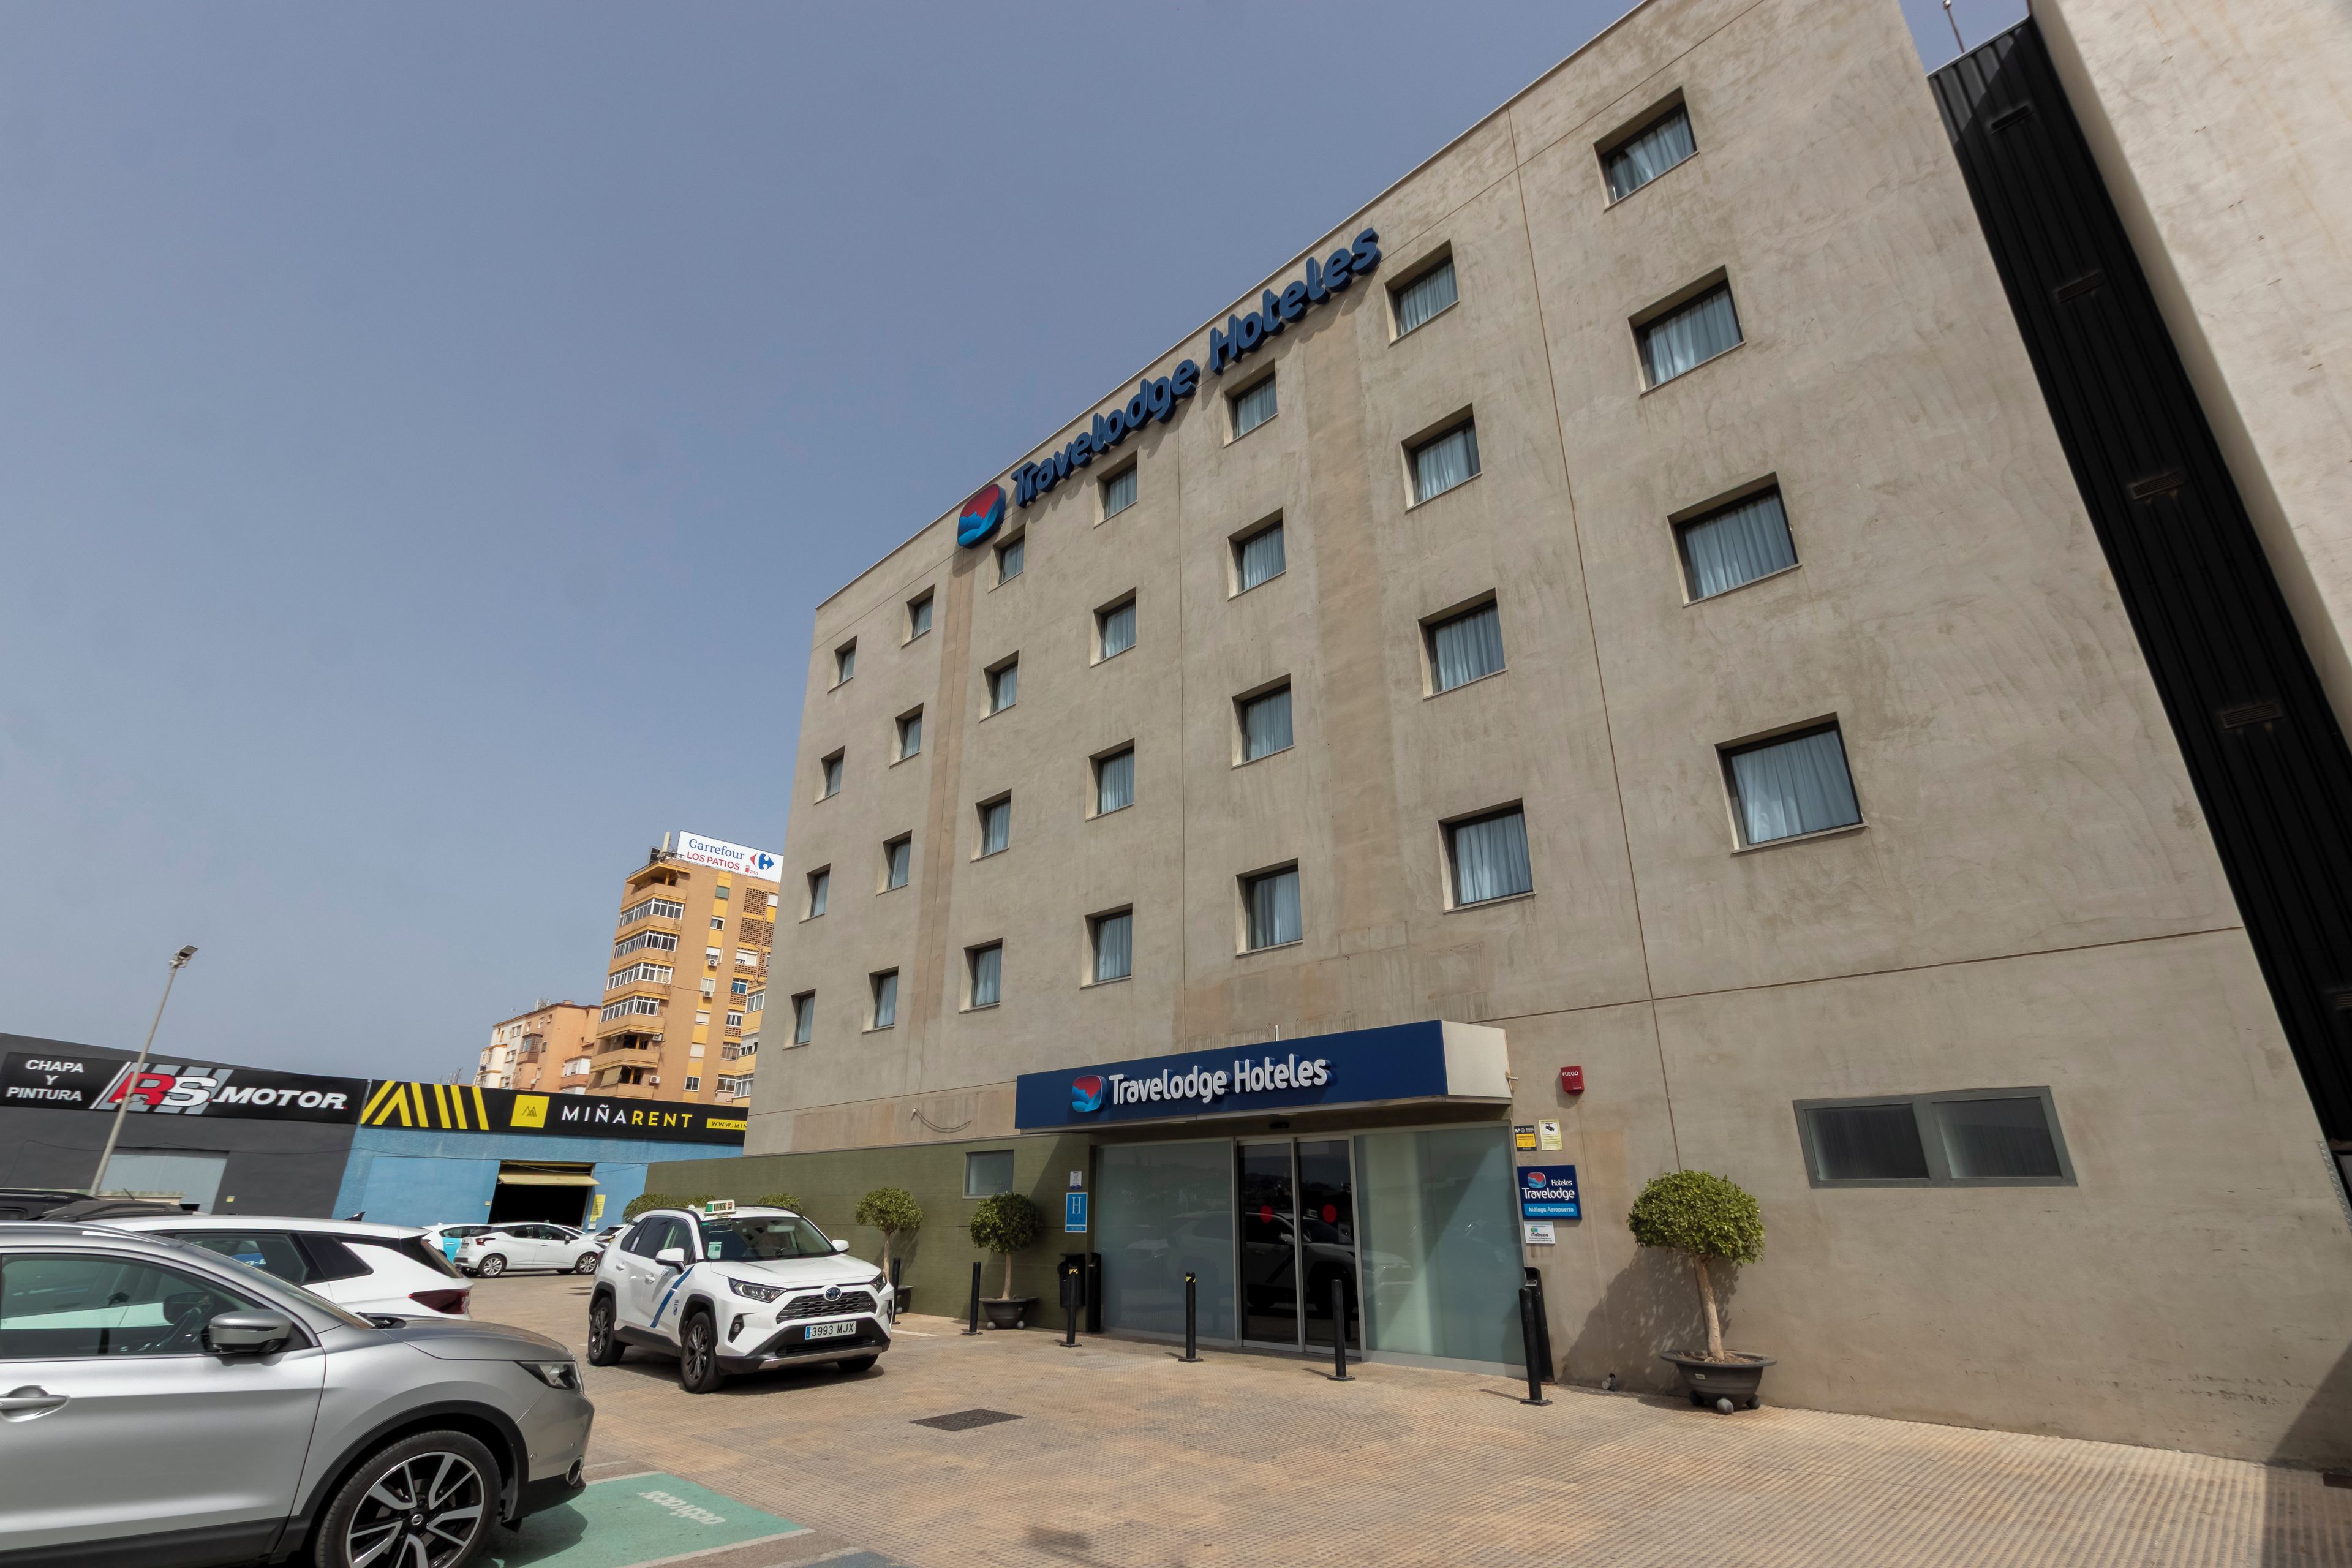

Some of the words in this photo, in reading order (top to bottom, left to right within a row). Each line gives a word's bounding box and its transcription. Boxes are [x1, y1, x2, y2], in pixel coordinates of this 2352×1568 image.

[1011, 358, 1200, 508] Travelodge
[1209, 227, 1382, 375] Hoteles
[688, 838, 745, 860] Carrefour
[687, 851, 705, 862] LOS
[707, 856, 740, 870] PATIOS
[25, 1060, 84, 1073] CHAPA
[45, 1075, 59, 1085] Y
[1109, 1065, 1229, 1104] Travelodge
[1234, 1053, 1329, 1094] Hoteles
[5, 1087, 82, 1101] PINTURA
[107, 1071, 219, 1107] RS
[212, 1085, 348, 1109] MOTOR
[561, 1104, 693, 1128] MIÑARENT
[1521, 1187, 1575, 1201] Travelodge
[1072, 1196, 1082, 1214] H
[812, 1325, 834, 1336] 3993
[837, 1323, 854, 1334] MJX
